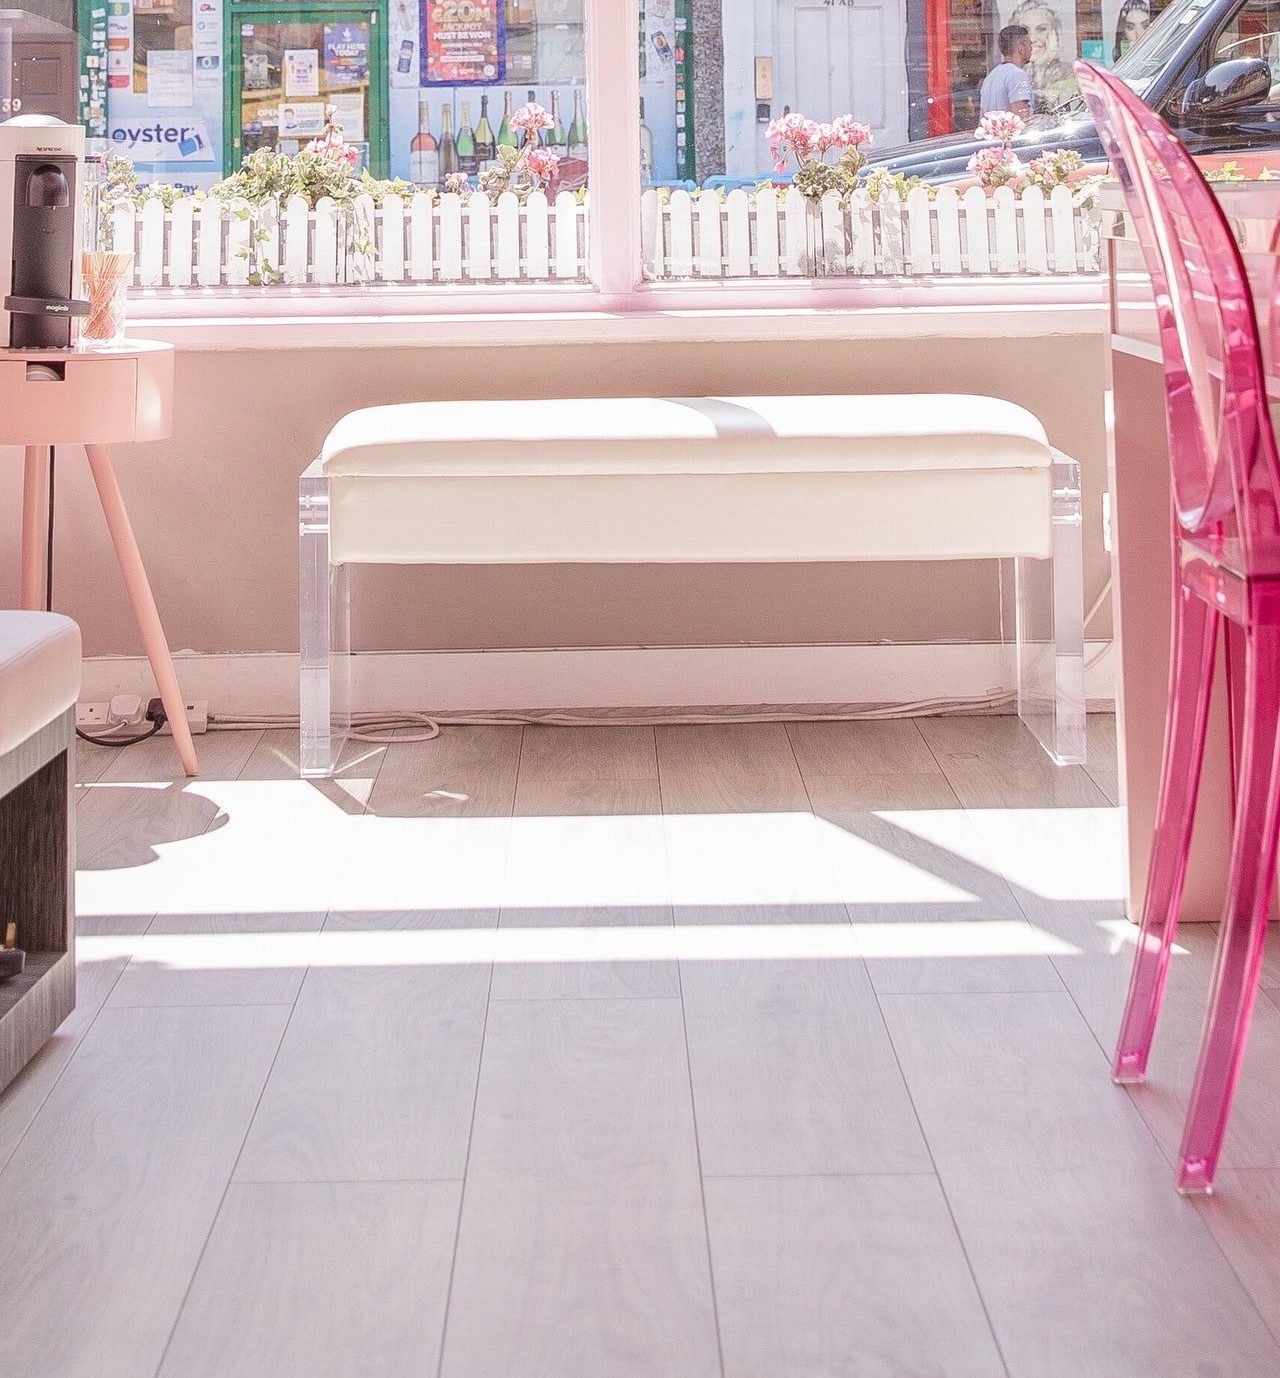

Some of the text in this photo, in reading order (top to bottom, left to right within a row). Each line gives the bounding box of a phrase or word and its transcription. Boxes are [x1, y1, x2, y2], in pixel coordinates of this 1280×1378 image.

[433, 31, 457, 40] MUST
[468, 31, 491, 39] WON
[1, 98, 22, 113] 39
[112, 123, 190, 150] oyster
